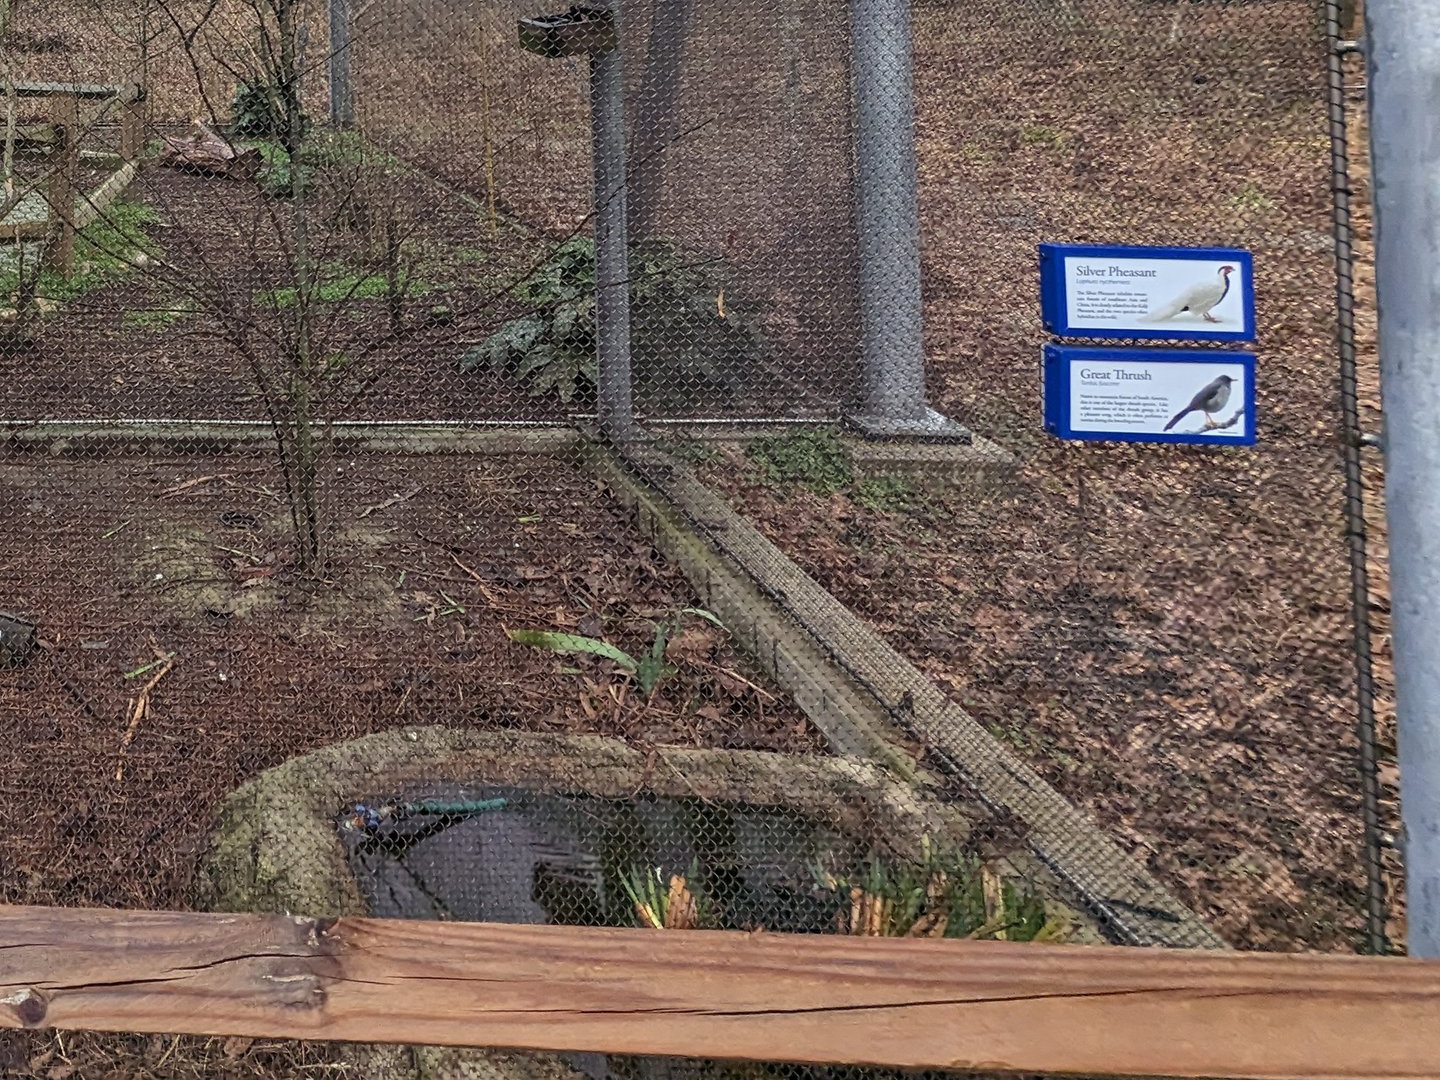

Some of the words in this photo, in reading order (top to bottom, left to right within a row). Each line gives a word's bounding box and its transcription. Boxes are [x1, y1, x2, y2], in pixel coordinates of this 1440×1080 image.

[1076, 265, 1106, 277] Silver
[1108, 266, 1157, 278] Pheasant
[1080, 368, 1111, 380] Great
[1113, 369, 1152, 381] Thrush
